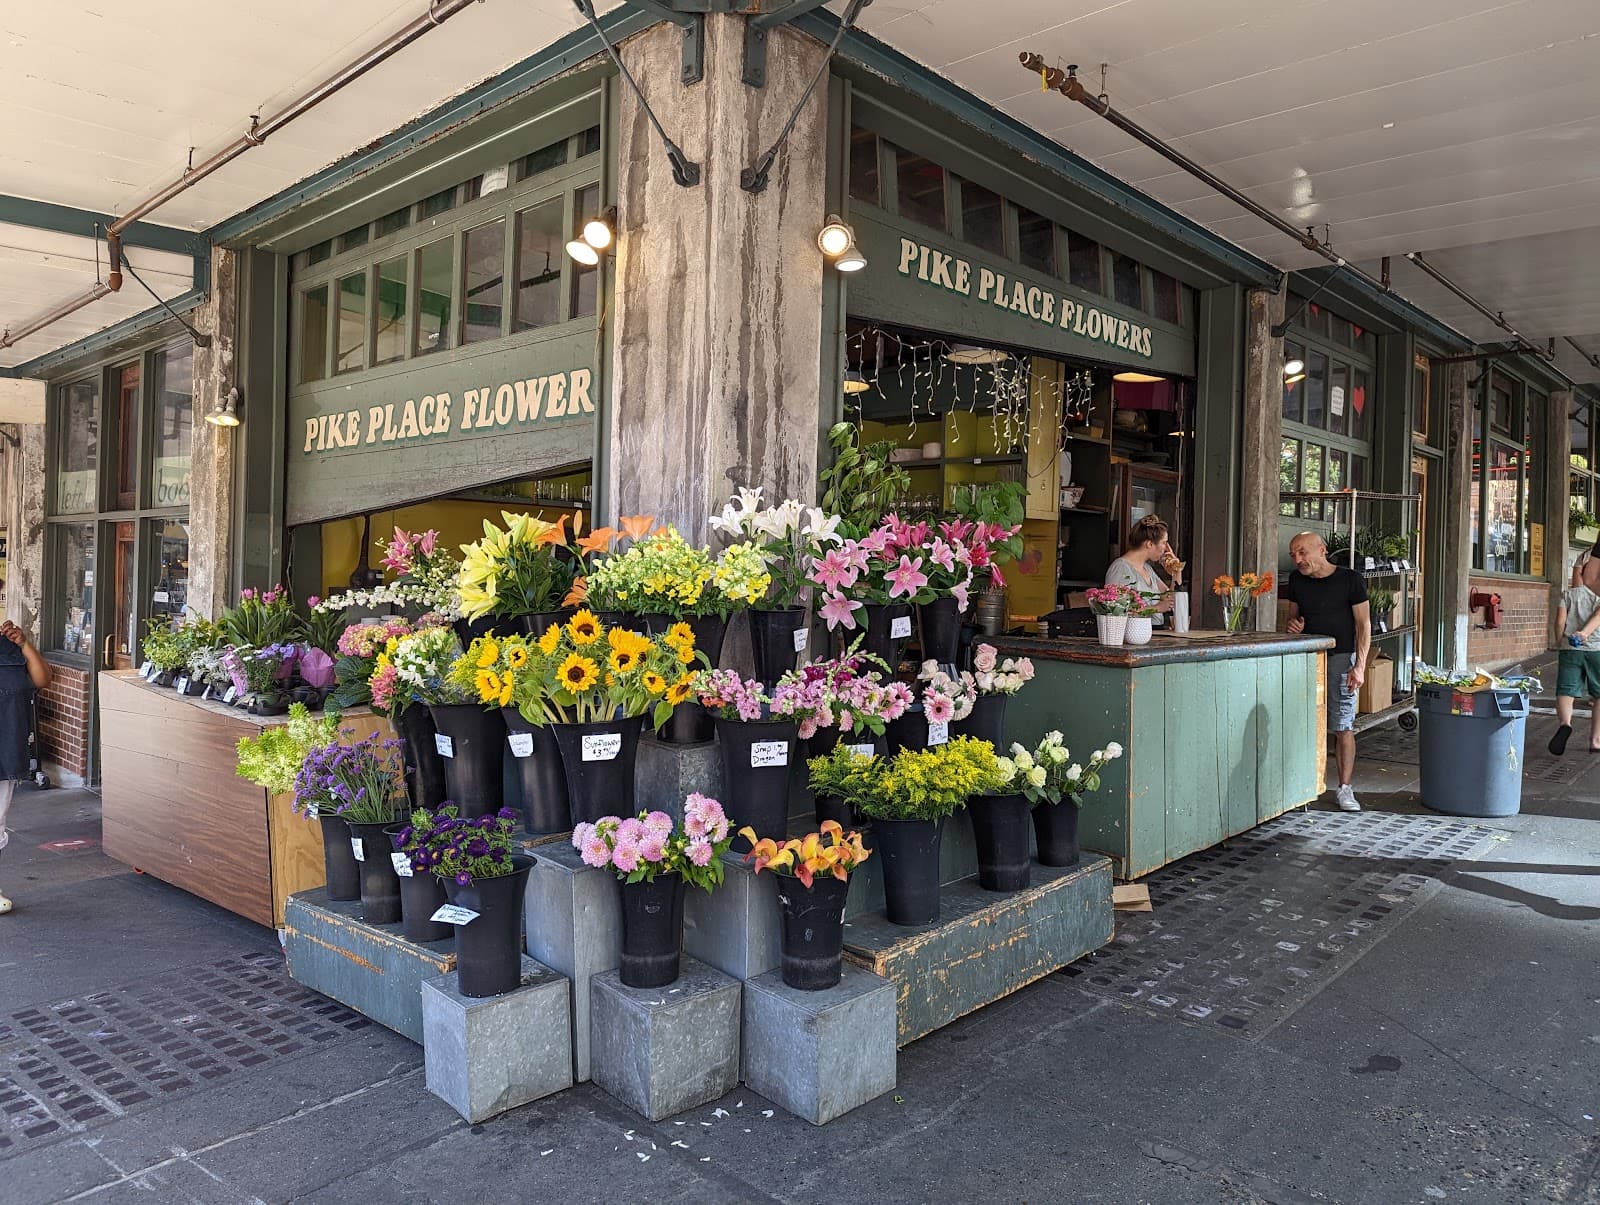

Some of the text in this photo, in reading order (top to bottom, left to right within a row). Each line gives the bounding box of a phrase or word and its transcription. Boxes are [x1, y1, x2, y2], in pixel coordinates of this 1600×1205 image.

[898, 238, 1153, 358] PIKE PLACE FLOWERS
[303, 368, 596, 453] PIKE PLACE FLOWER
